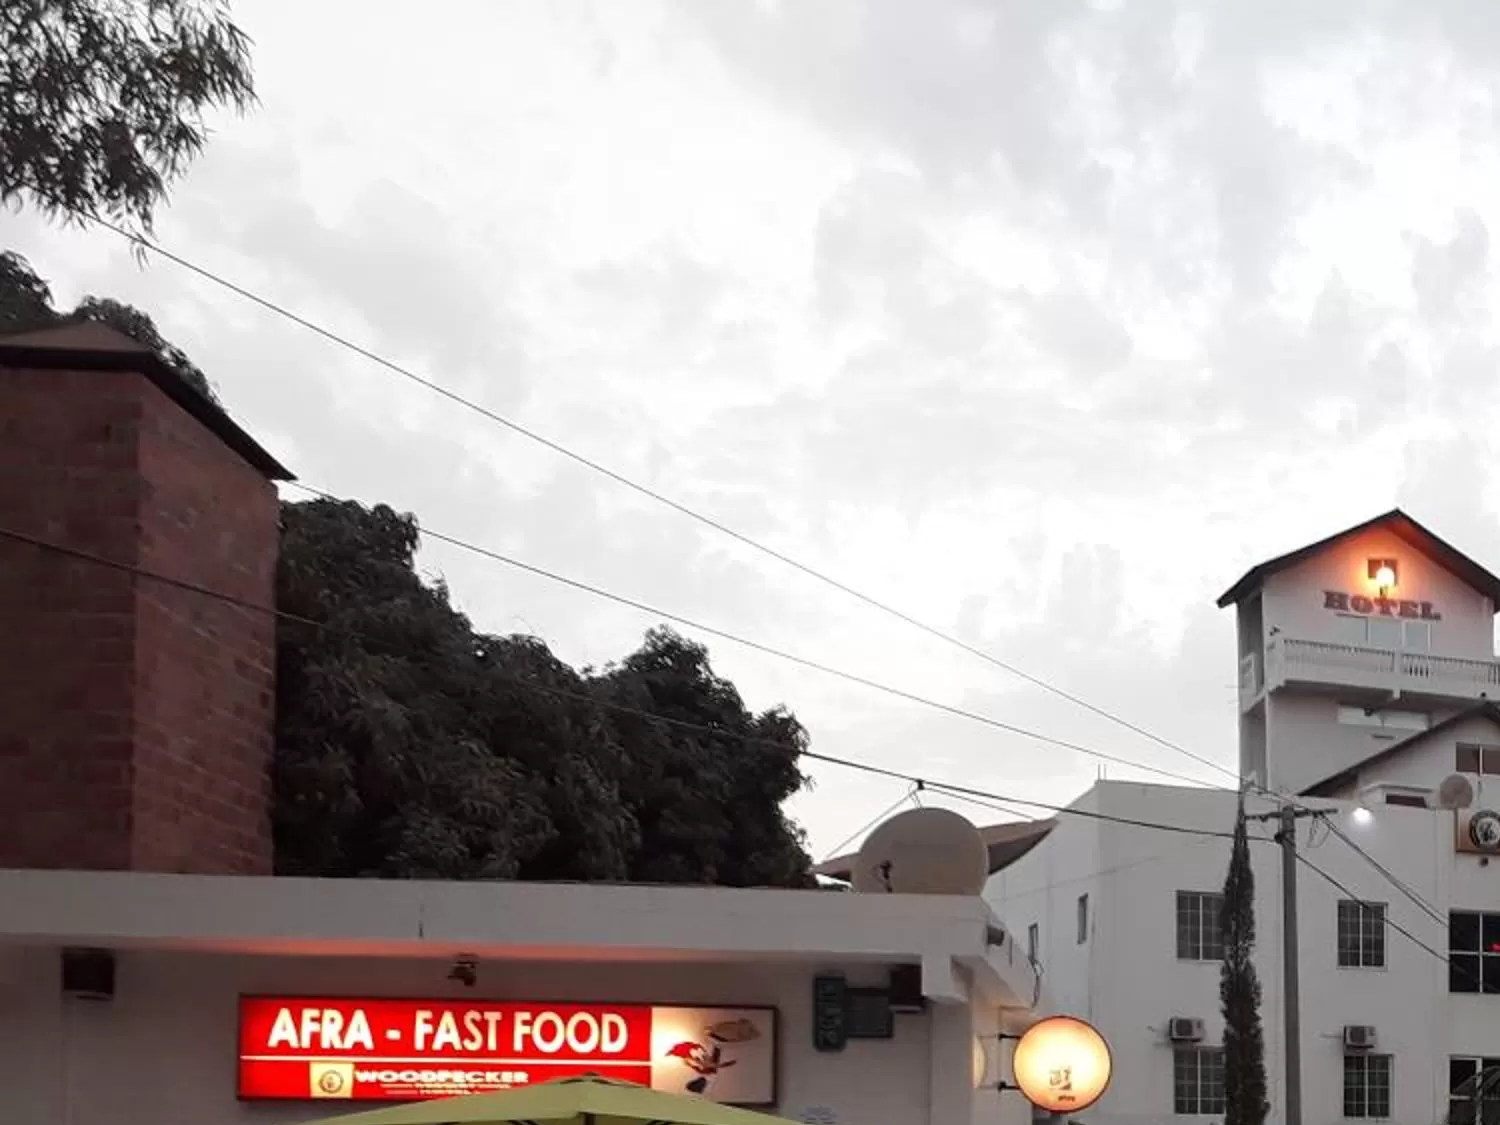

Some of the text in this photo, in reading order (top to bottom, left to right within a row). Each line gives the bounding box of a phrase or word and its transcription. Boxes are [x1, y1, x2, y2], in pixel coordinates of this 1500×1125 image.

[1323, 591, 1441, 620] HOTEL
[268, 1008, 374, 1050] AFRA
[414, 1010, 502, 1051] FAST
[513, 1012, 629, 1053] FOOD
[356, 1070, 529, 1083] WOODPECKER
